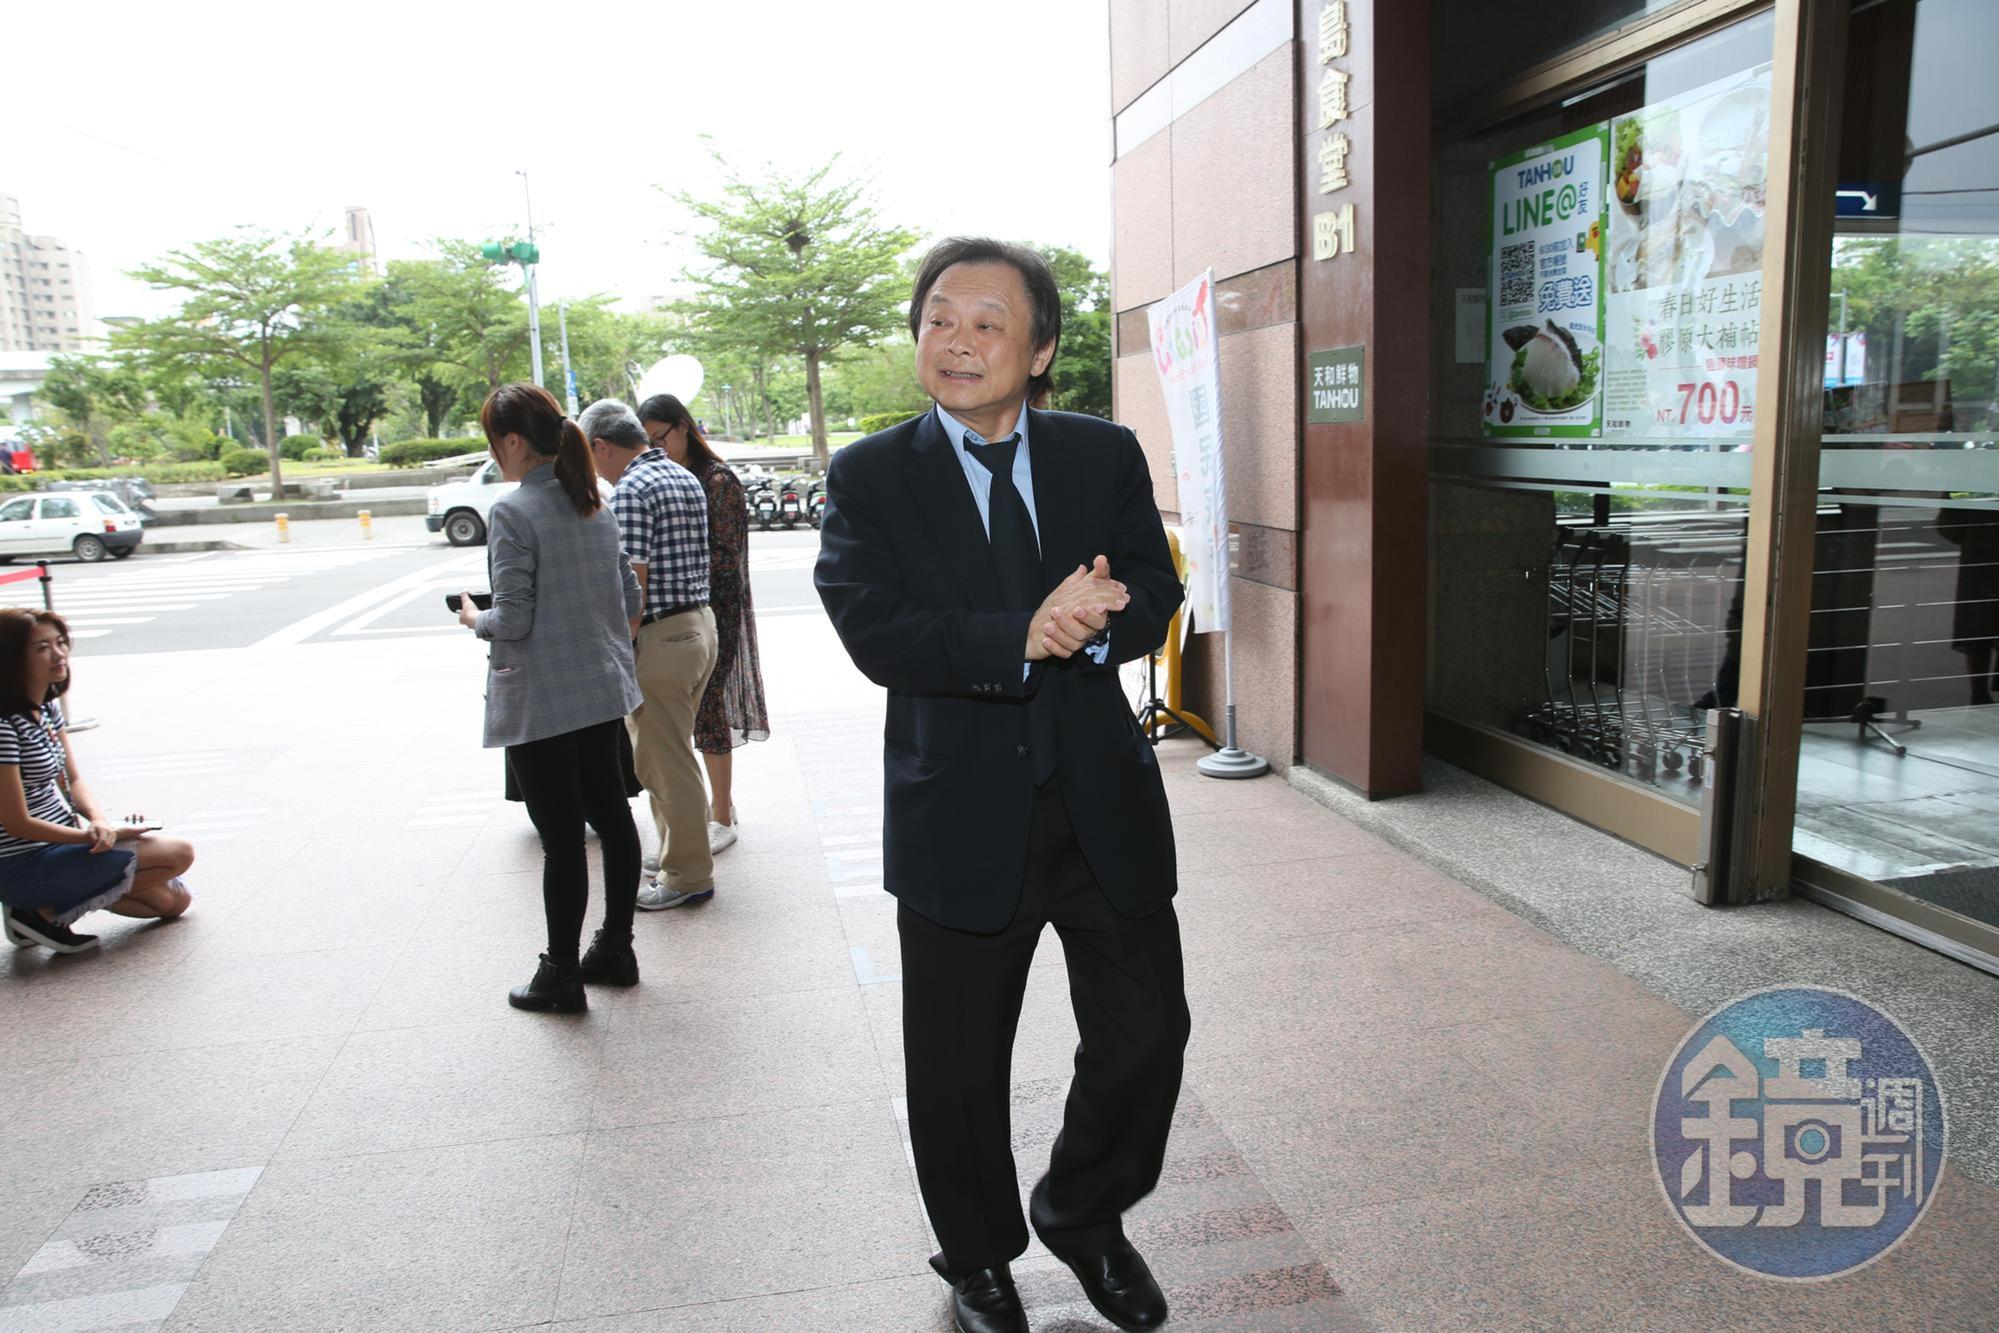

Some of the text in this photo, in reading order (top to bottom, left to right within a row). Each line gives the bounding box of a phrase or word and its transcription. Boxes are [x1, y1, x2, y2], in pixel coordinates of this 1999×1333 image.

[1517, 155, 1575, 190] TANHOU
[1503, 184, 1577, 235] LINE@
[1577, 181, 1589, 215] 好友
[1313, 203, 1354, 261] B1
[1538, 275, 1593, 313] 免費送
[1659, 280, 1762, 320] 春日好生活
[1660, 319, 1760, 356] 膠原大補帖
[1313, 362, 1359, 387] 天和鮮物
[1313, 388, 1358, 409] TANHOU
